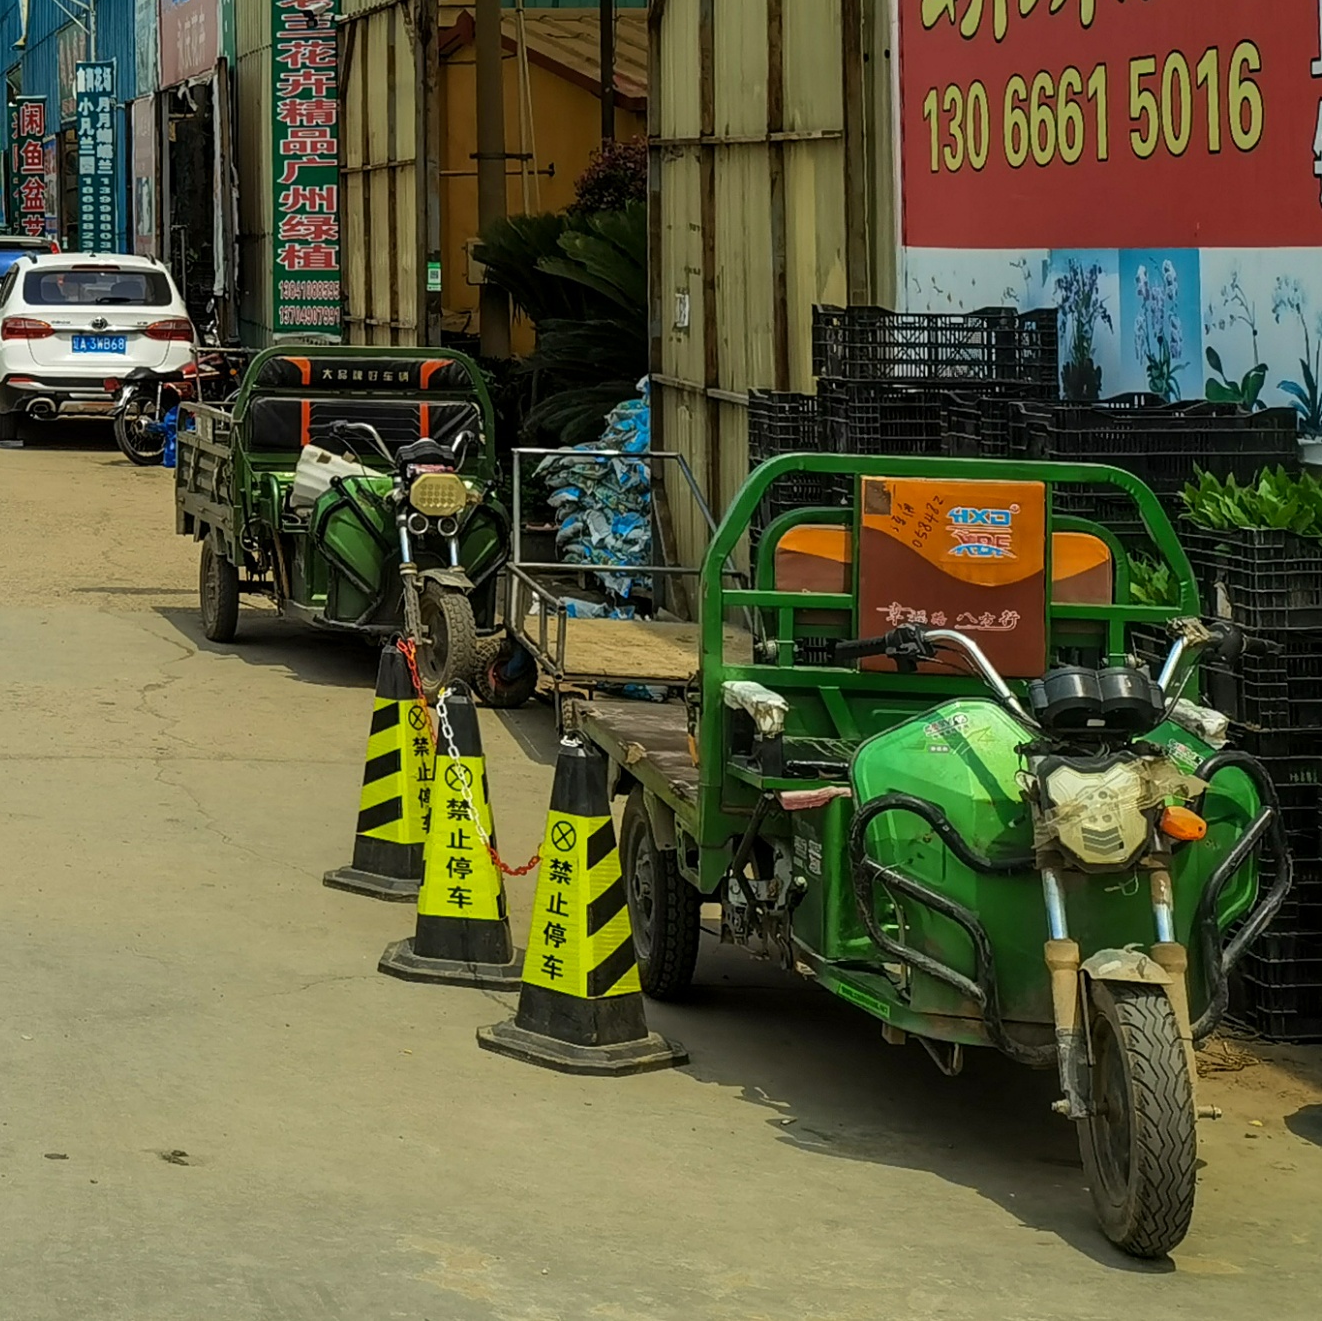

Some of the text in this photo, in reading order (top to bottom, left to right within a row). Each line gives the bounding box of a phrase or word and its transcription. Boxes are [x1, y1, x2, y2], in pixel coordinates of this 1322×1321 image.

[923, 40, 1264, 174] 130 6661 5016
[446, 797, 473, 909] 禁止停车
[541, 858, 572, 981] 禁止停车
